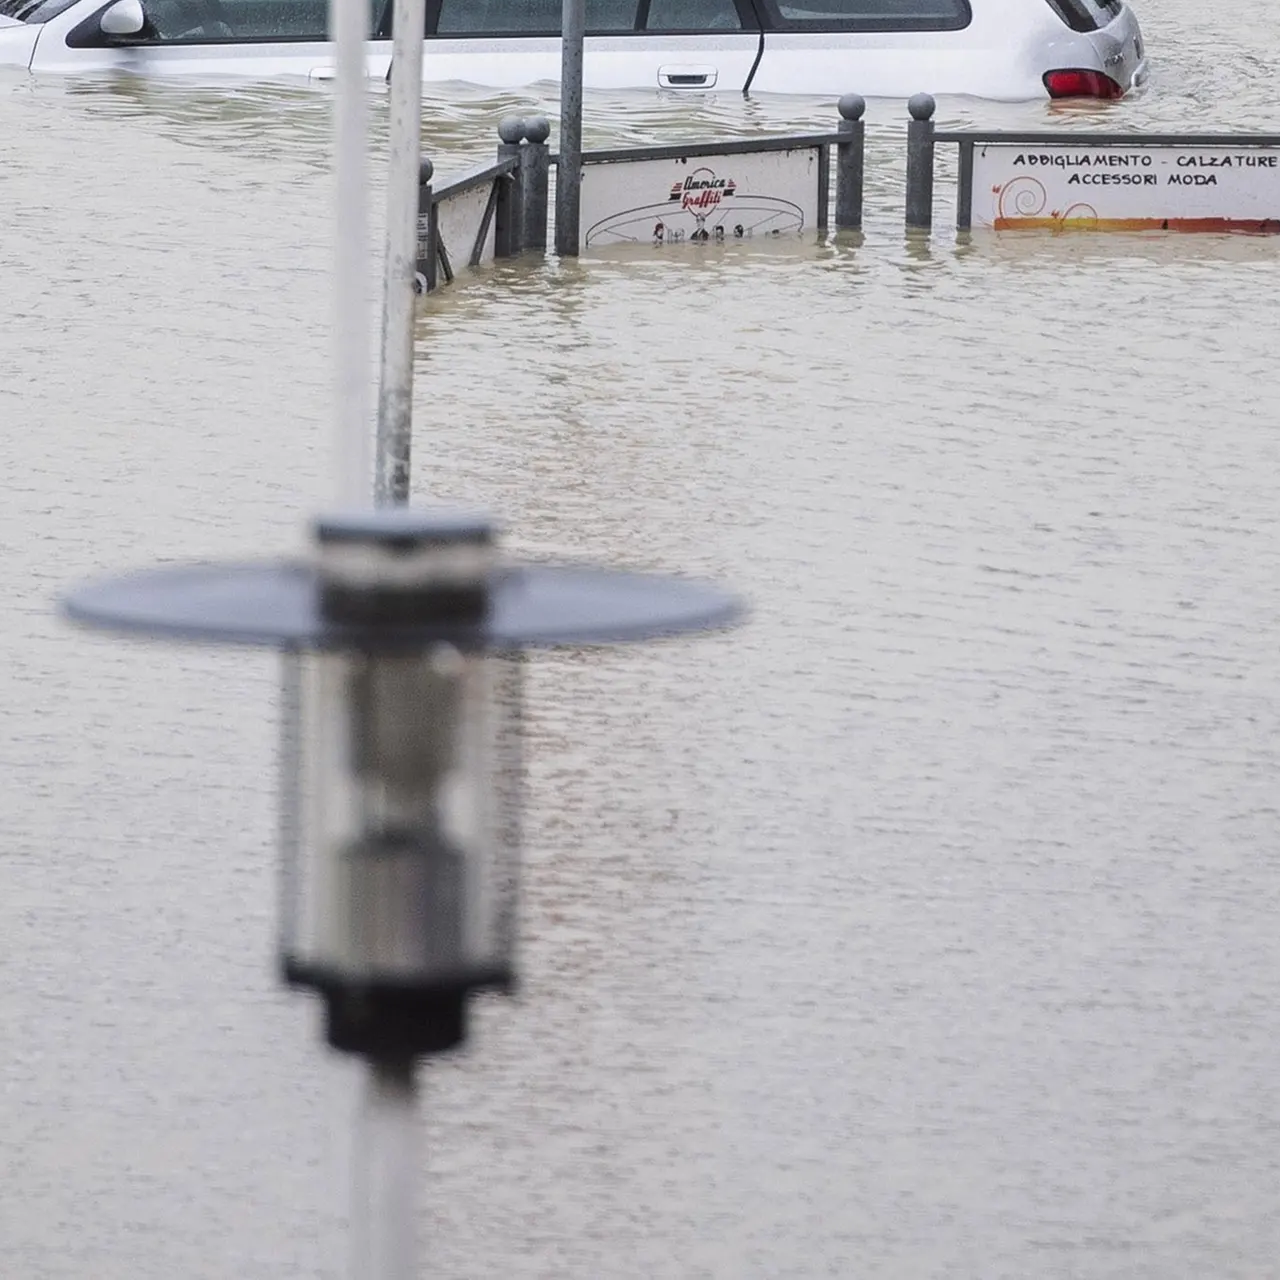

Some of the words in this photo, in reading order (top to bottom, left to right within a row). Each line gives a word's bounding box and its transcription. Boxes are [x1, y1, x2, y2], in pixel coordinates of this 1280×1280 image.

[1013, 154, 1152, 169] ABBIGLIAMENTO
[1176, 155, 1279, 168] CALZATURE
[1067, 173, 1158, 186] ACCESSORI
[1167, 174, 1218, 186] MODA
